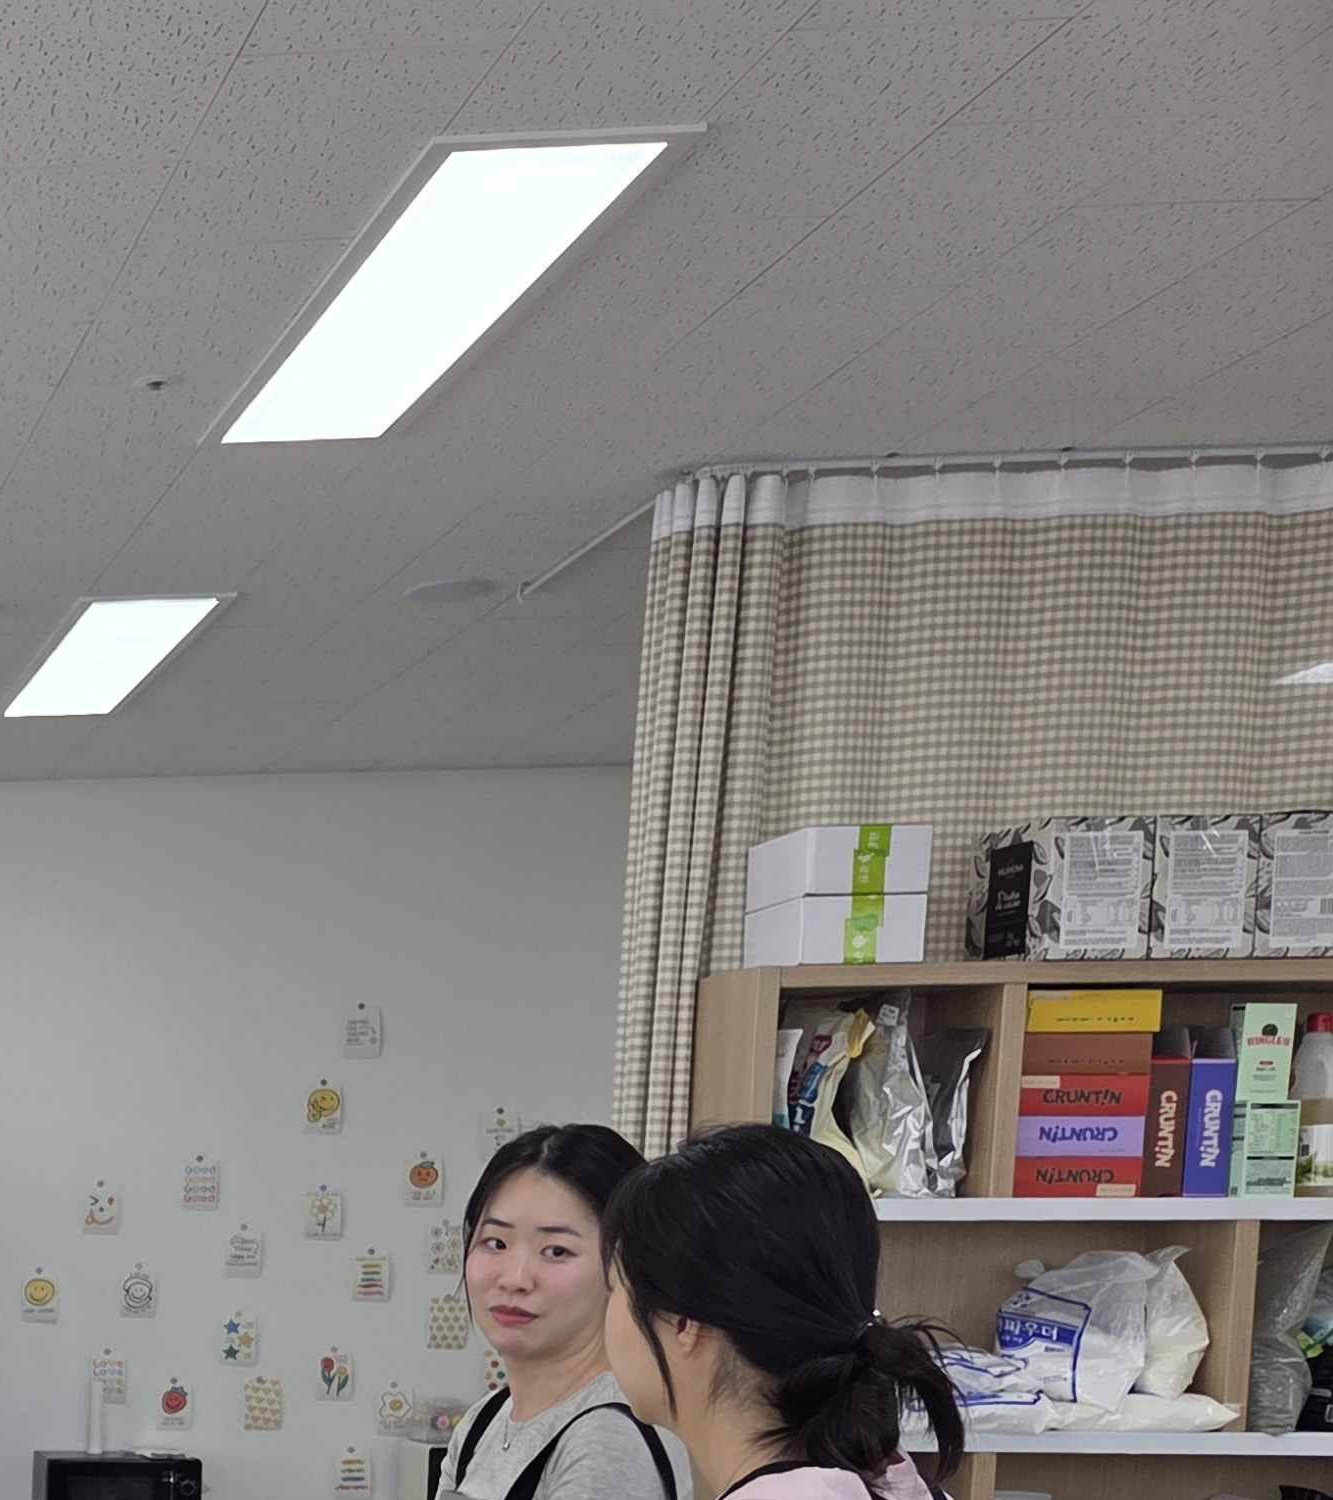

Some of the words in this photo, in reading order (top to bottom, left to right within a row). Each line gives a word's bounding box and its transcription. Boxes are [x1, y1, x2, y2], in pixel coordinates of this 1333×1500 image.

[1042, 1088, 1122, 1106] CRUNT!N
[1038, 1125, 1119, 1143] CRUNT!N
[1154, 1090, 1178, 1168] CRUNT!N
[1199, 1088, 1223, 1168] CRUNT!N
[1035, 1168, 1115, 1184] CRUNT!N
